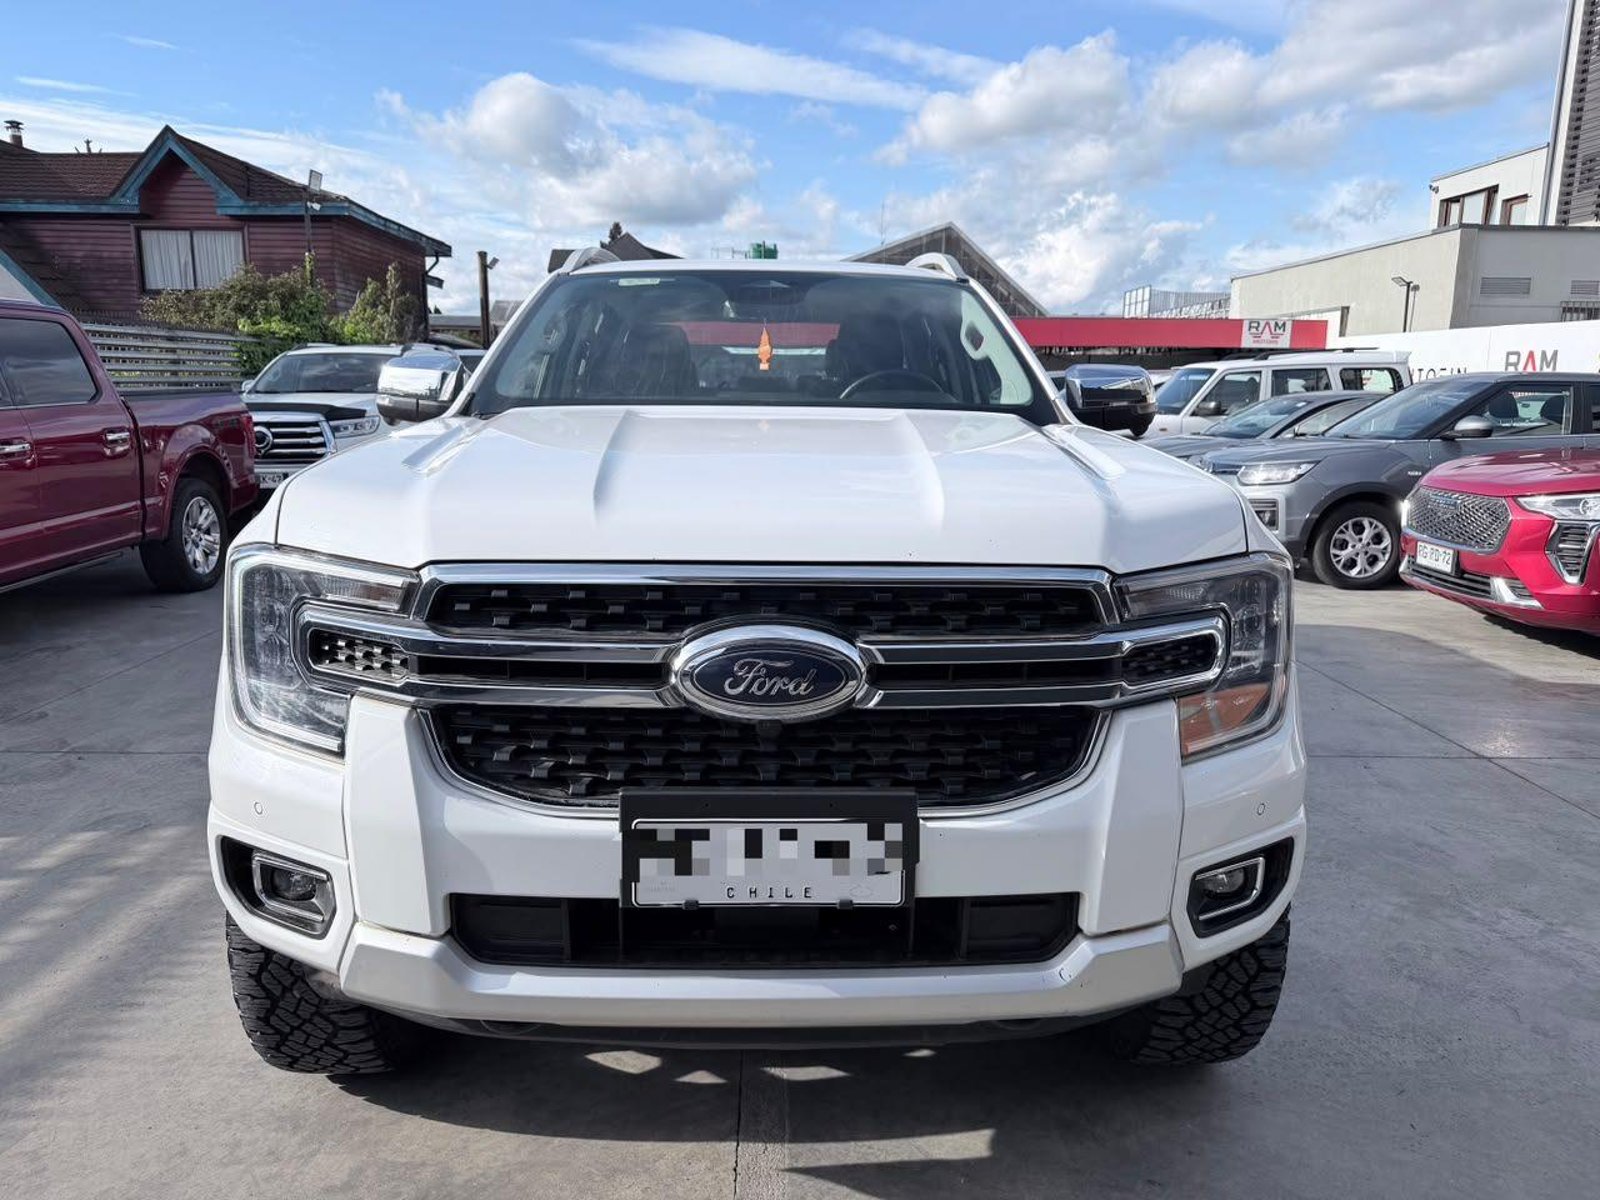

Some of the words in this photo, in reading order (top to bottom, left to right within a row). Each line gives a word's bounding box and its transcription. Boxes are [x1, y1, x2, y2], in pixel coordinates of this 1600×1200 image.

[1248, 320, 1287, 335] RAM
[1504, 349, 1559, 372] RAM
[724, 658, 817, 695] Ford
[726, 887, 813, 899] CHILE
